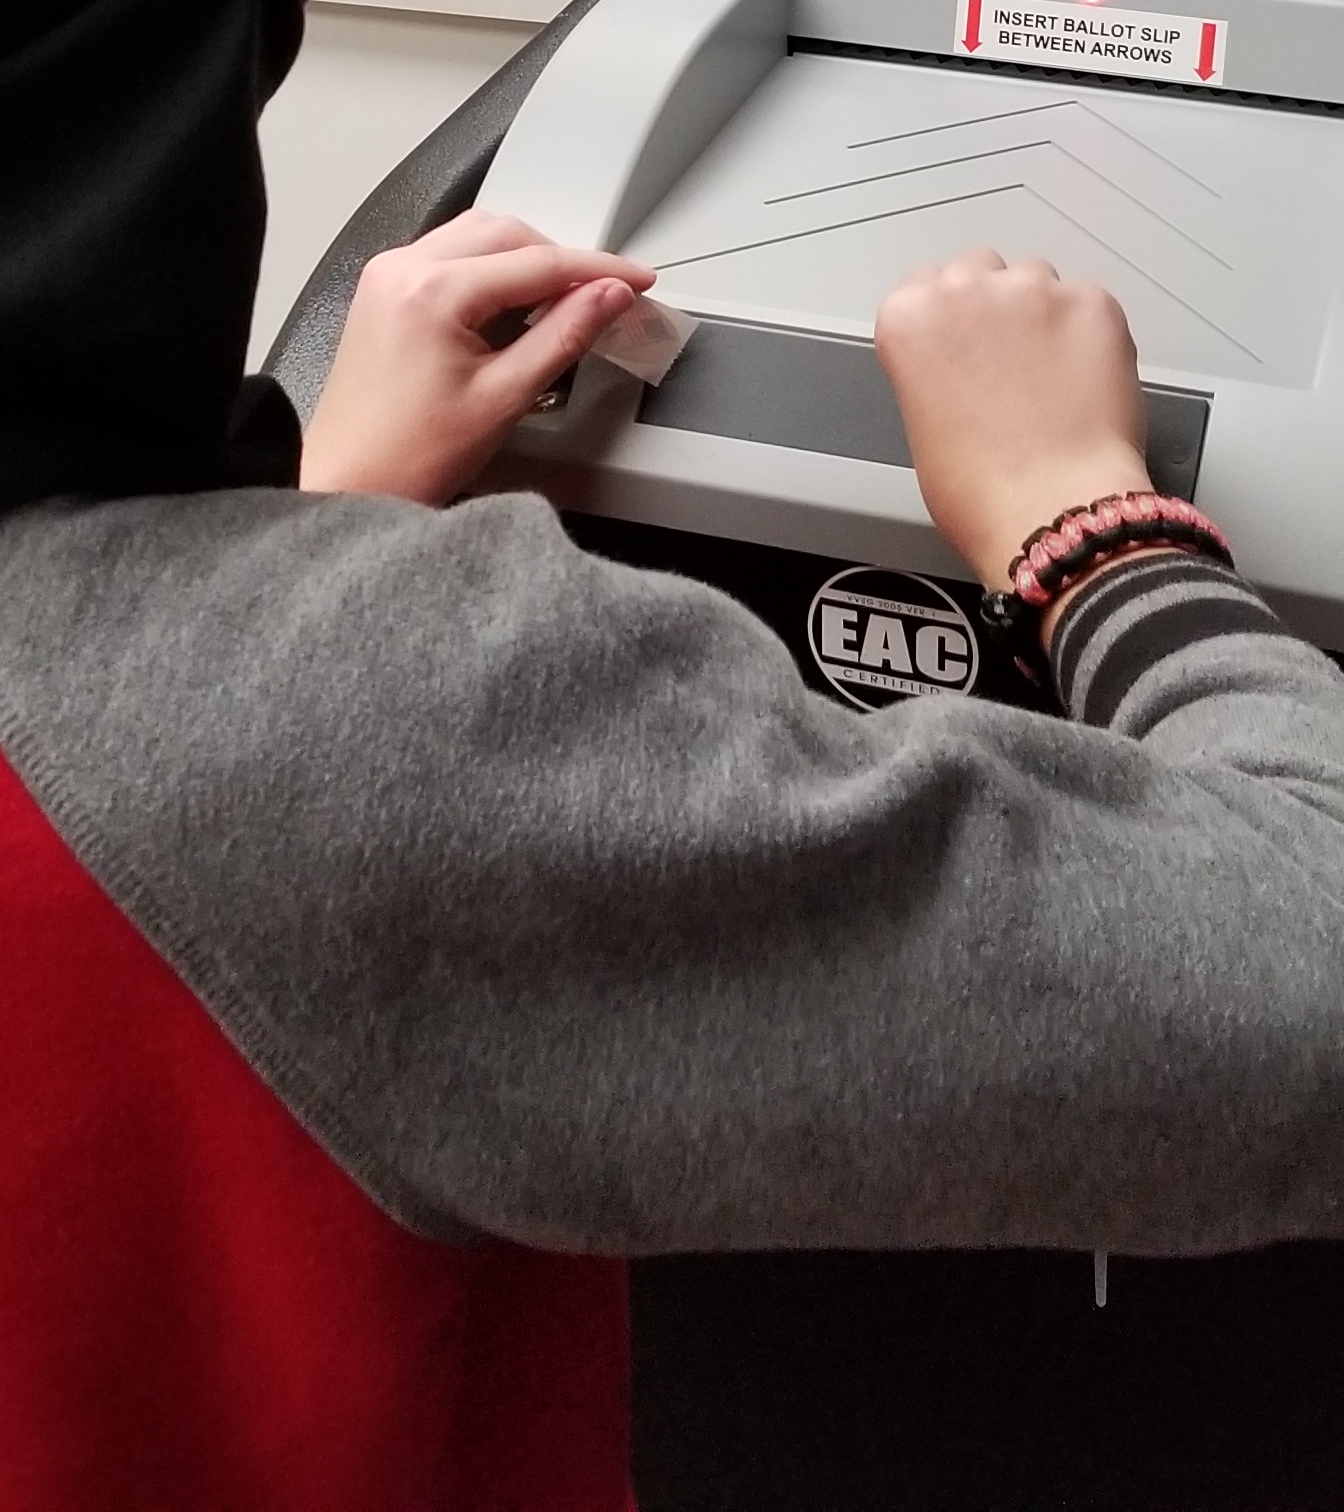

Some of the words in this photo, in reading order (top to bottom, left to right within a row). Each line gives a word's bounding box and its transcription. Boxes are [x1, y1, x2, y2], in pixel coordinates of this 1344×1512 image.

[993, 9, 1059, 31] INSERT
[1063, 18, 1136, 40] BALLOT
[1140, 26, 1182, 45] SLIP
[998, 30, 1086, 54] BETWEEN
[1089, 41, 1173, 65] ARROWS
[821, 603, 968, 683] EAC
[843, 668, 941, 696] CERTIFIED
